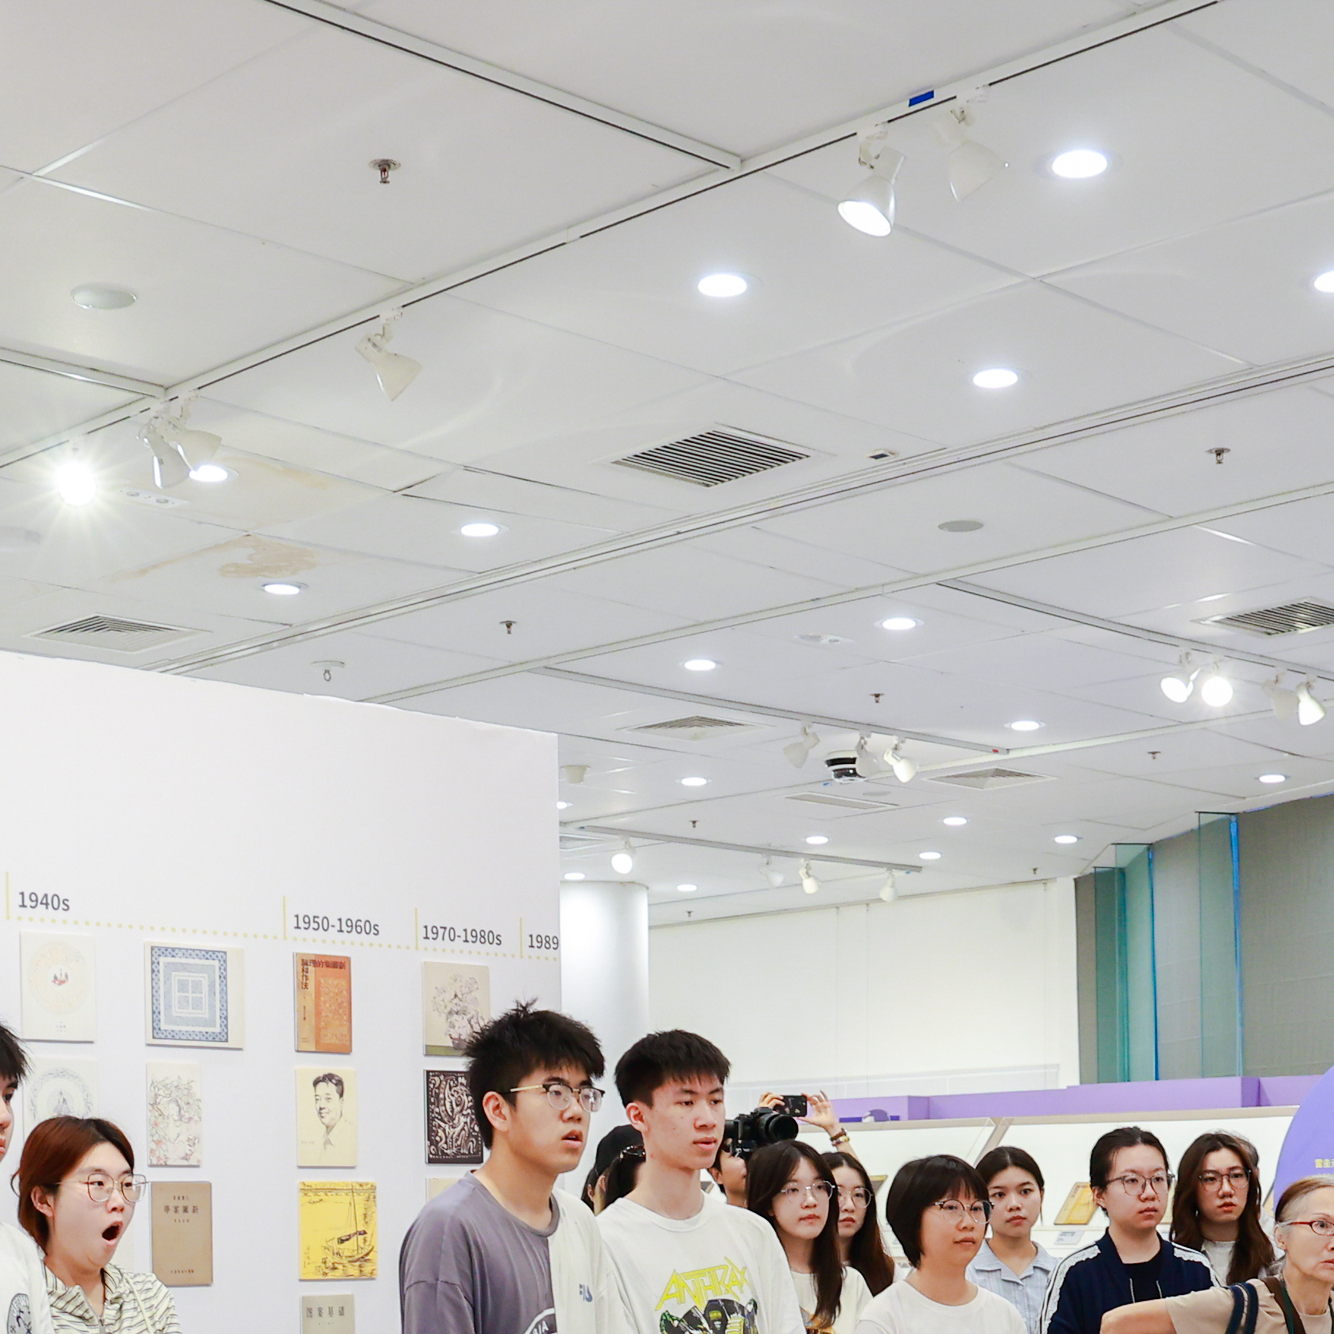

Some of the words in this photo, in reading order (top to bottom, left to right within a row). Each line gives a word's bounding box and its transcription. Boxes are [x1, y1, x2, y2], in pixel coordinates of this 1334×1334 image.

[18, 891, 70, 912] 1940s
[293, 913, 380, 936] 1950-1960s
[422, 924, 503, 947] 1970-1980s
[527, 933, 559, 951] 1989
[655, 1256, 750, 1311] ANTHRAX
